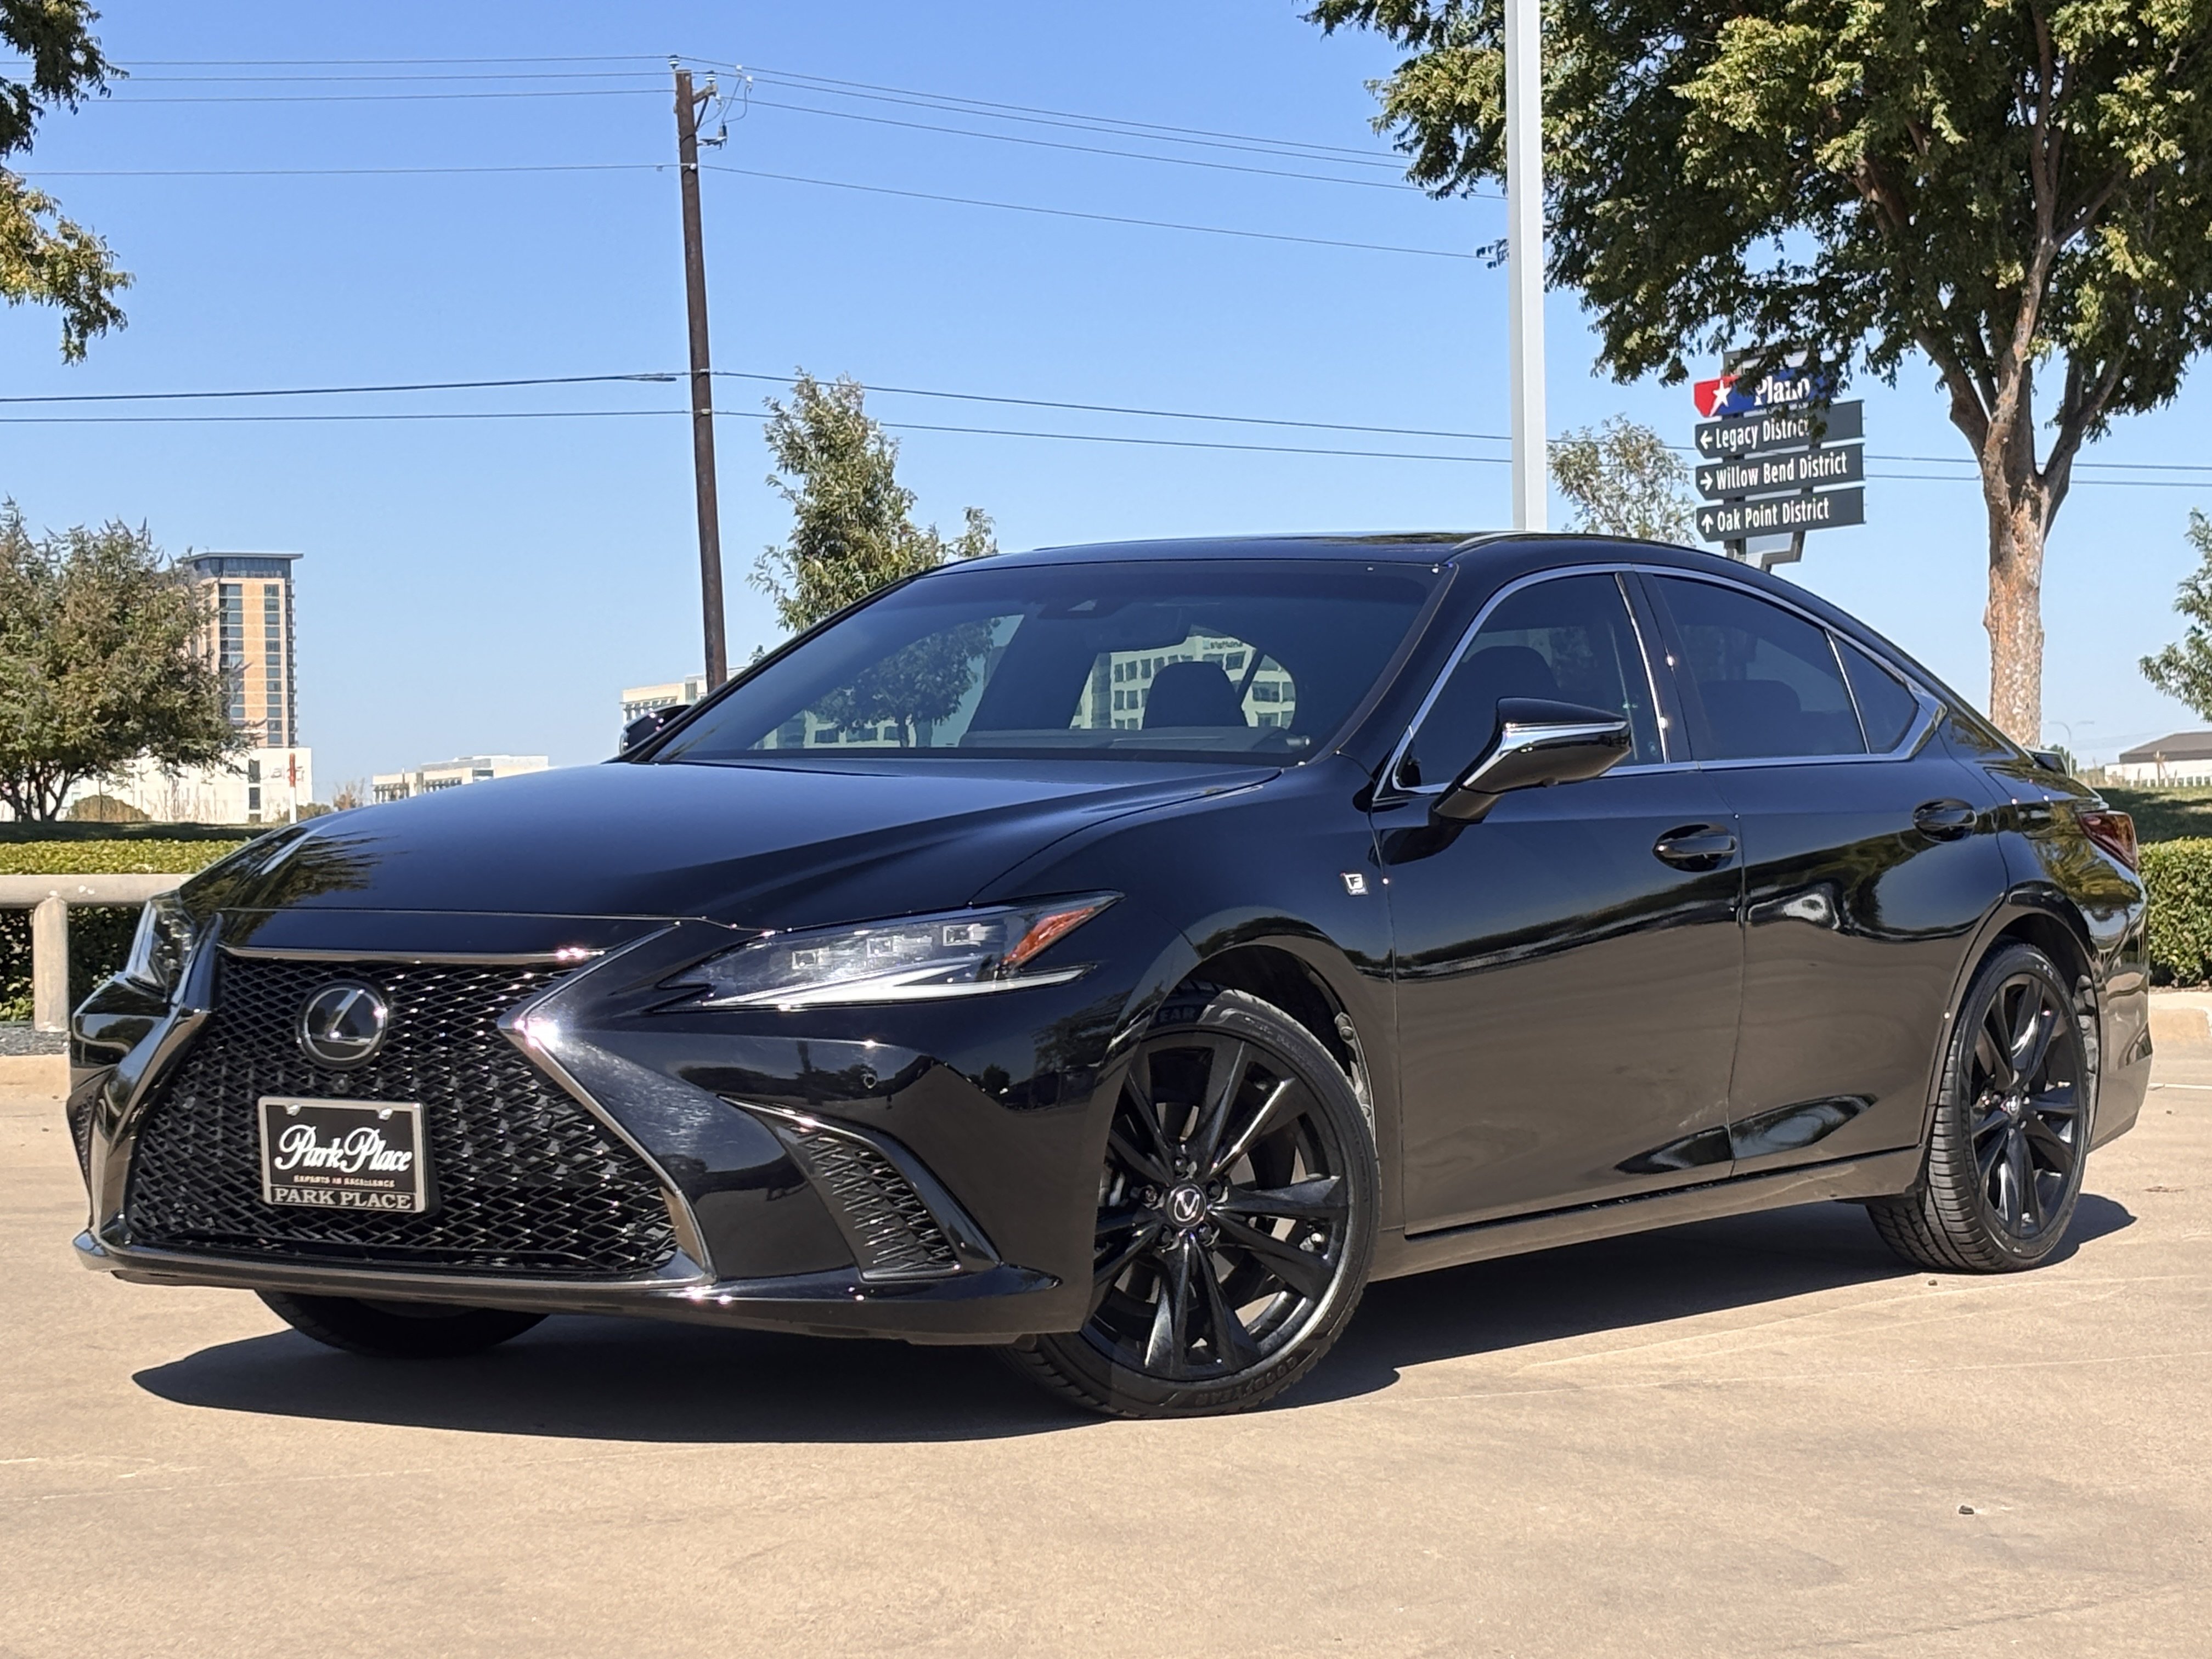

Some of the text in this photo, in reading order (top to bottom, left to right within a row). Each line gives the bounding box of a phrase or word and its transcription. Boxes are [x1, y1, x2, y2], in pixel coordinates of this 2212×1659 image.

[1716, 425, 1759, 453] Legacy
[1716, 451, 1848, 490] Willow Bend District
[1717, 497, 1830, 532] Oak Point District
[274, 1124, 413, 1173] Park Place
[274, 1188, 411, 1209] PARK PLACE
